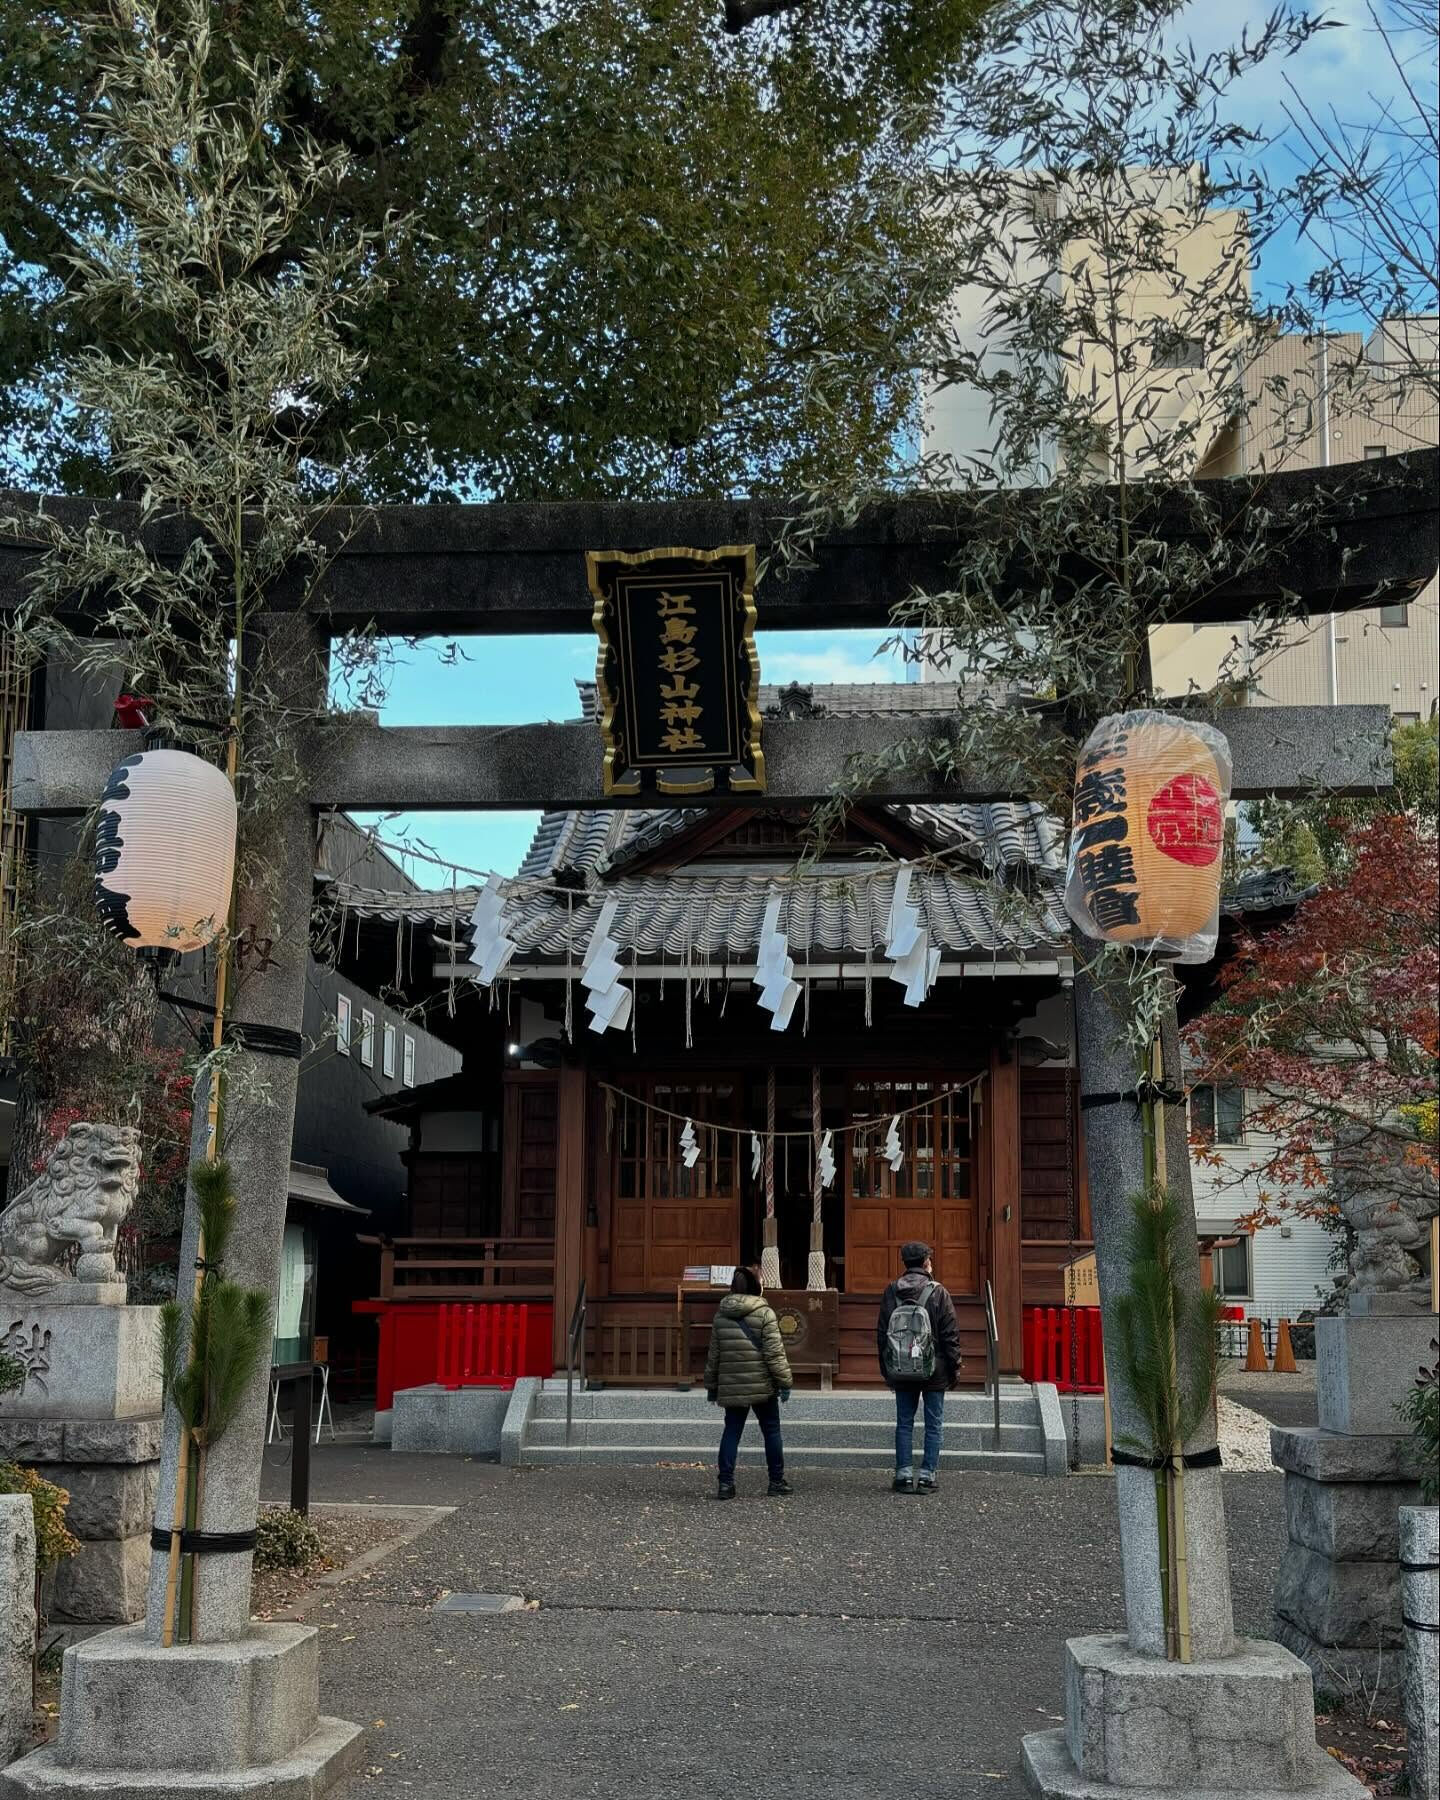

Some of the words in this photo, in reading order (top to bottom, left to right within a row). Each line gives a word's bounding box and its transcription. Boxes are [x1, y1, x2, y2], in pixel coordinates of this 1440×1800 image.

[656, 591, 706, 752] 江島杉山神社
